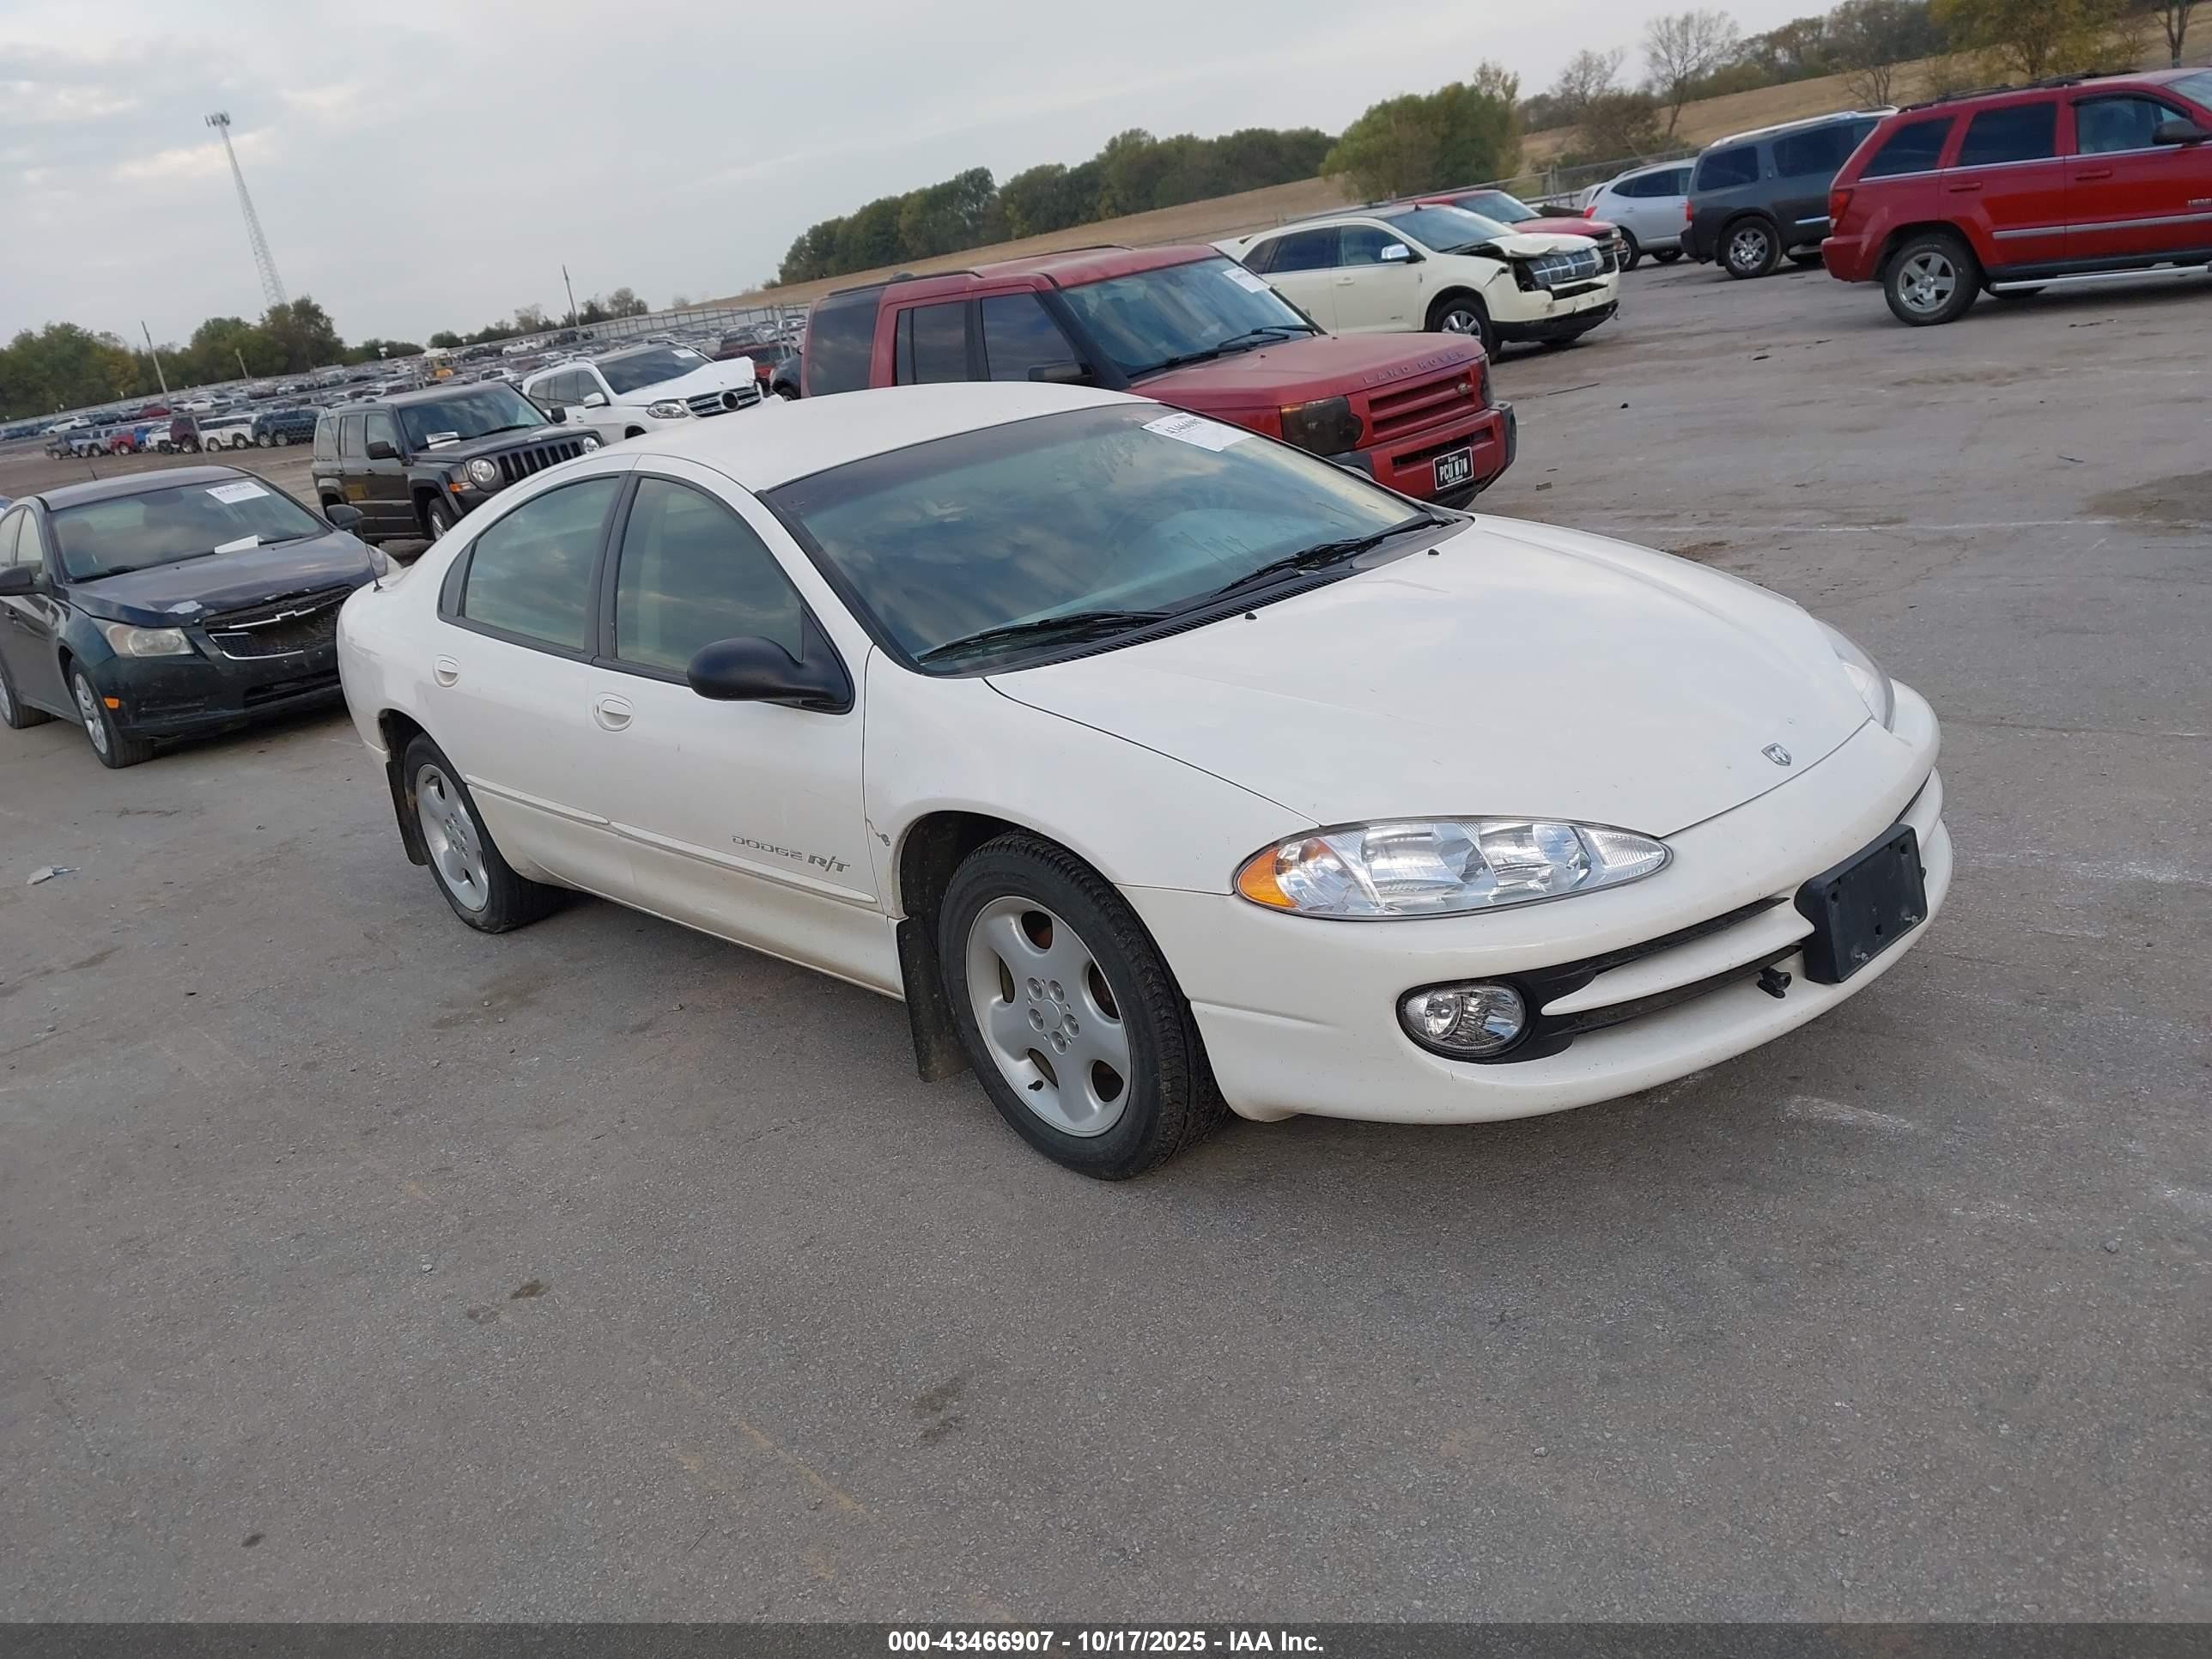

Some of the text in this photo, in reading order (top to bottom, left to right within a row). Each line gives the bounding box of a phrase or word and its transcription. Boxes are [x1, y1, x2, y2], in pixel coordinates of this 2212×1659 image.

[1439, 462, 1454, 482] PCU
[732, 836, 851, 872] DODGE R/T
